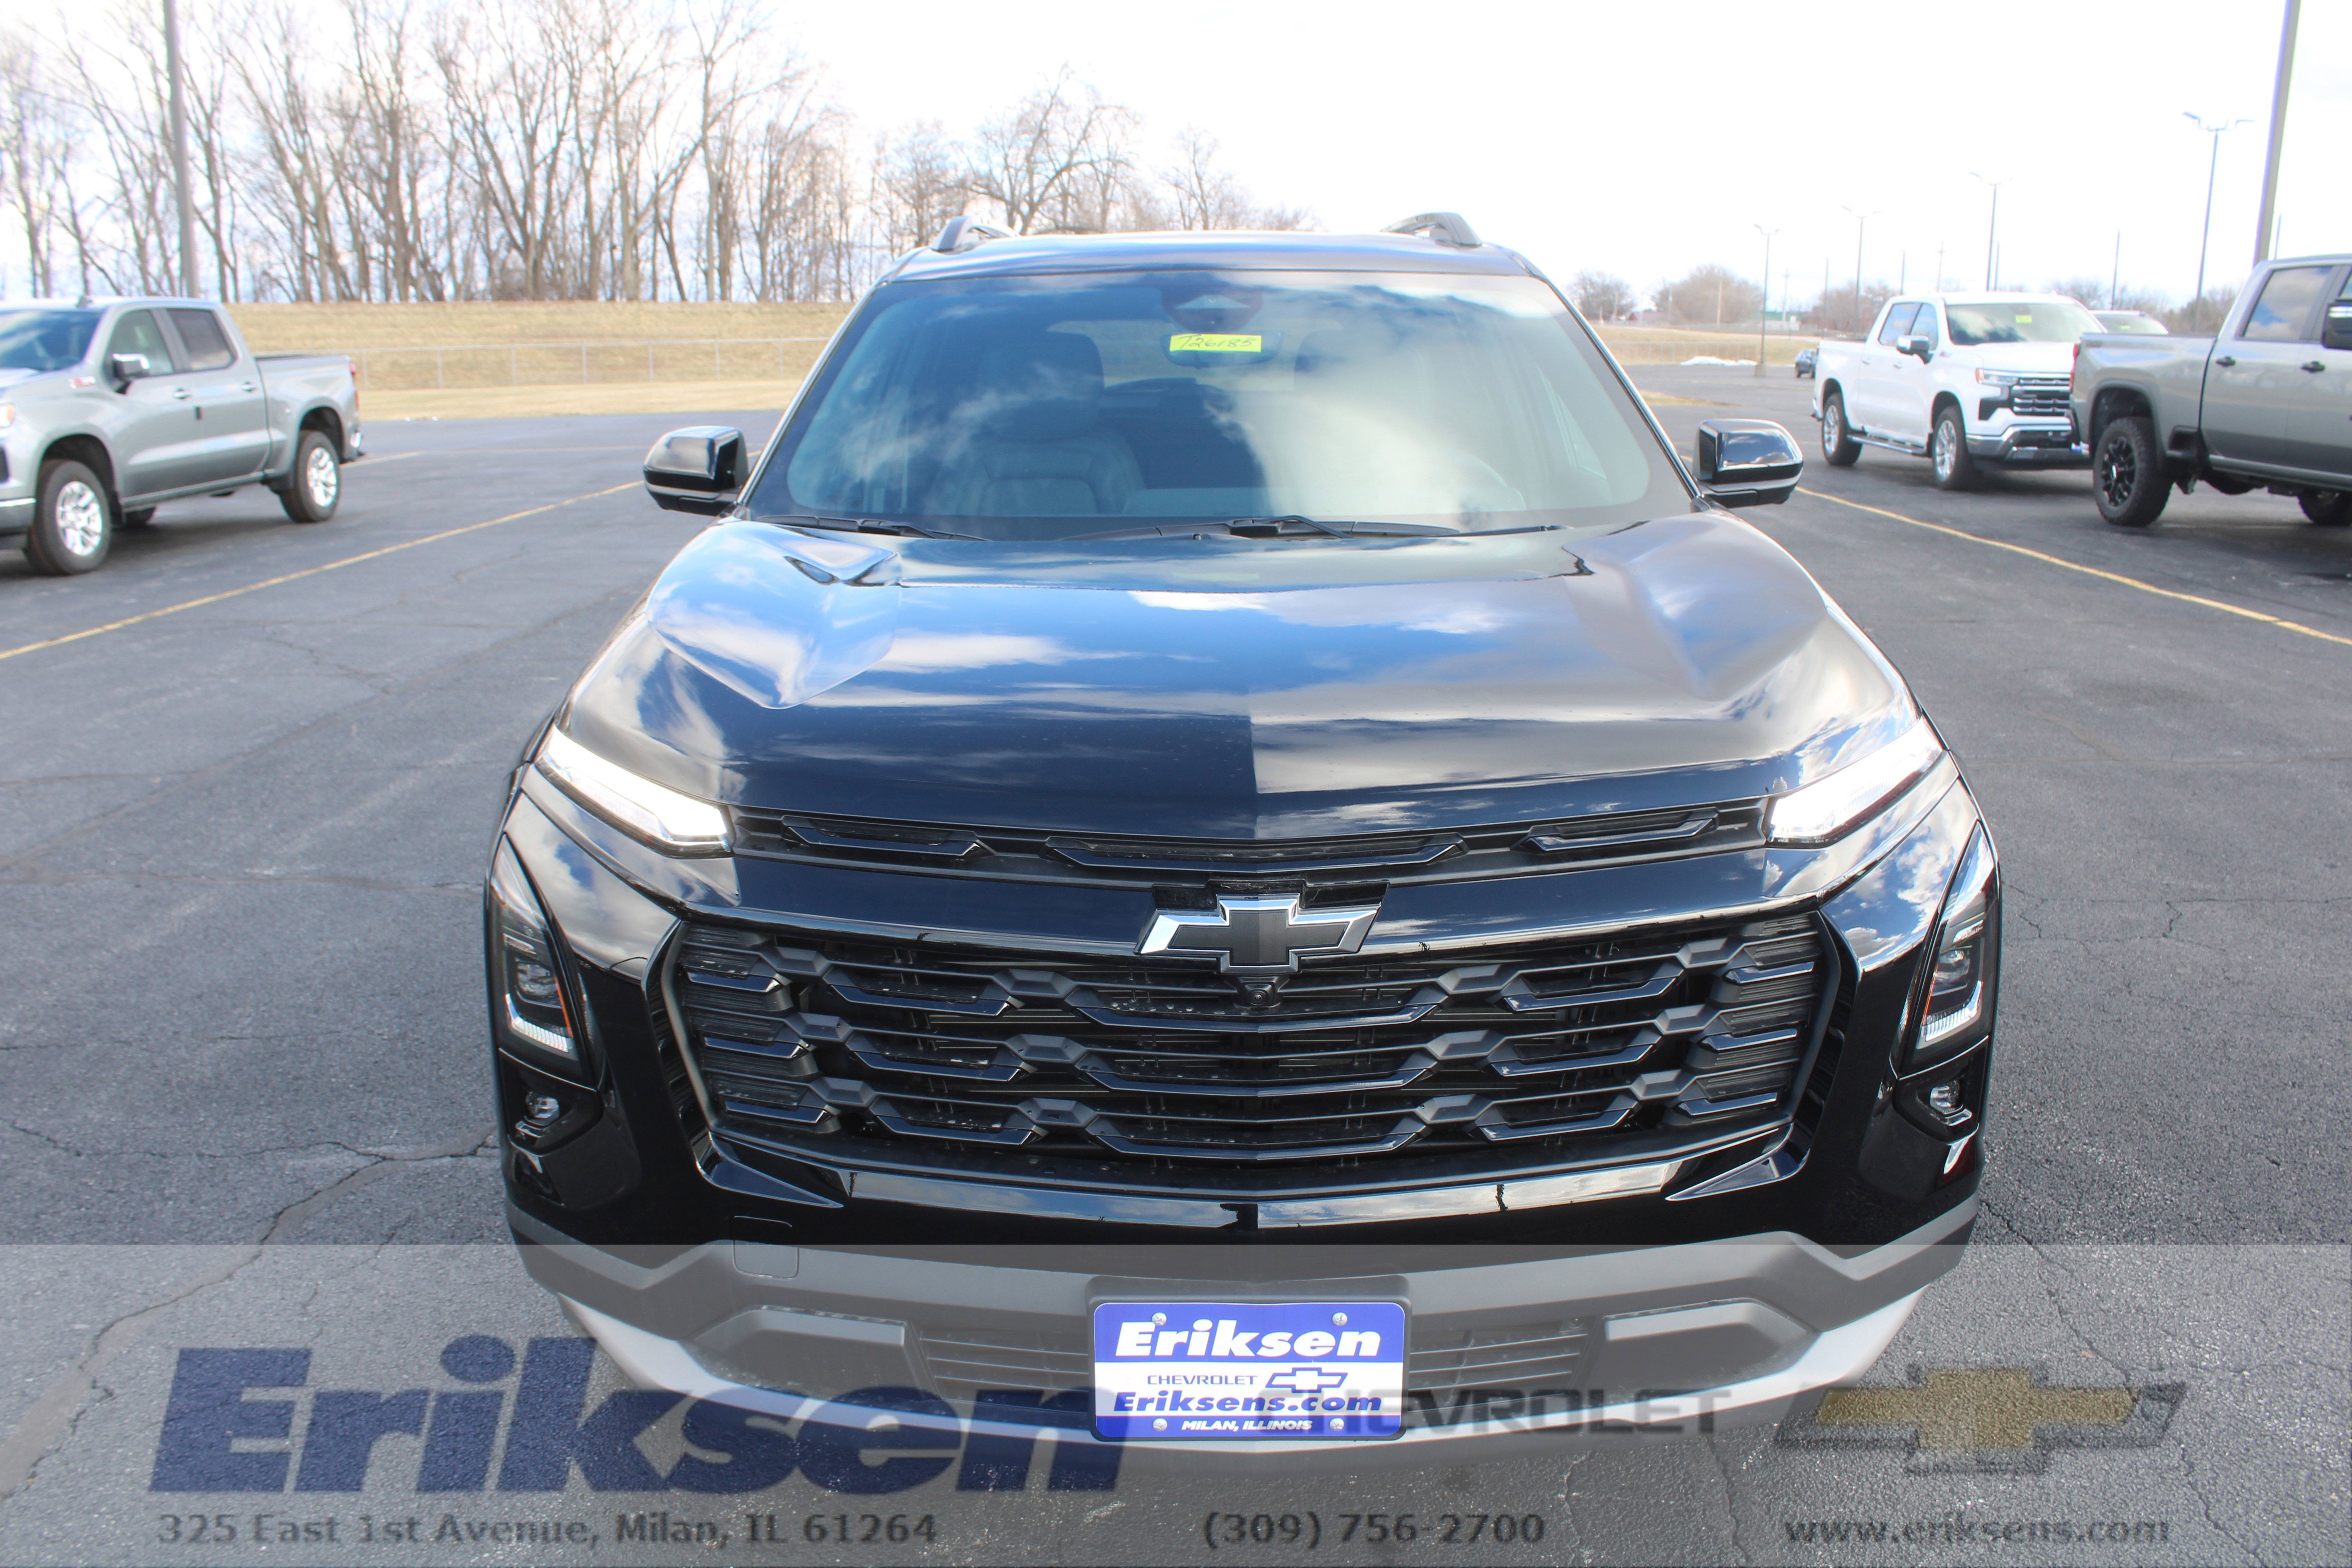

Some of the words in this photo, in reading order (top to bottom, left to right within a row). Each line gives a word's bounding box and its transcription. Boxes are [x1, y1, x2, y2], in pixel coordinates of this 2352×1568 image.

[1116, 1319, 1381, 1356] Eriksen
[1147, 1375, 1258, 1385] CHEVROLET
[1114, 1390, 1381, 1412] Eriksens.com
[1182, 1420, 1239, 1432] MILAN,
[1242, 1420, 1312, 1430] ILLINOIS
